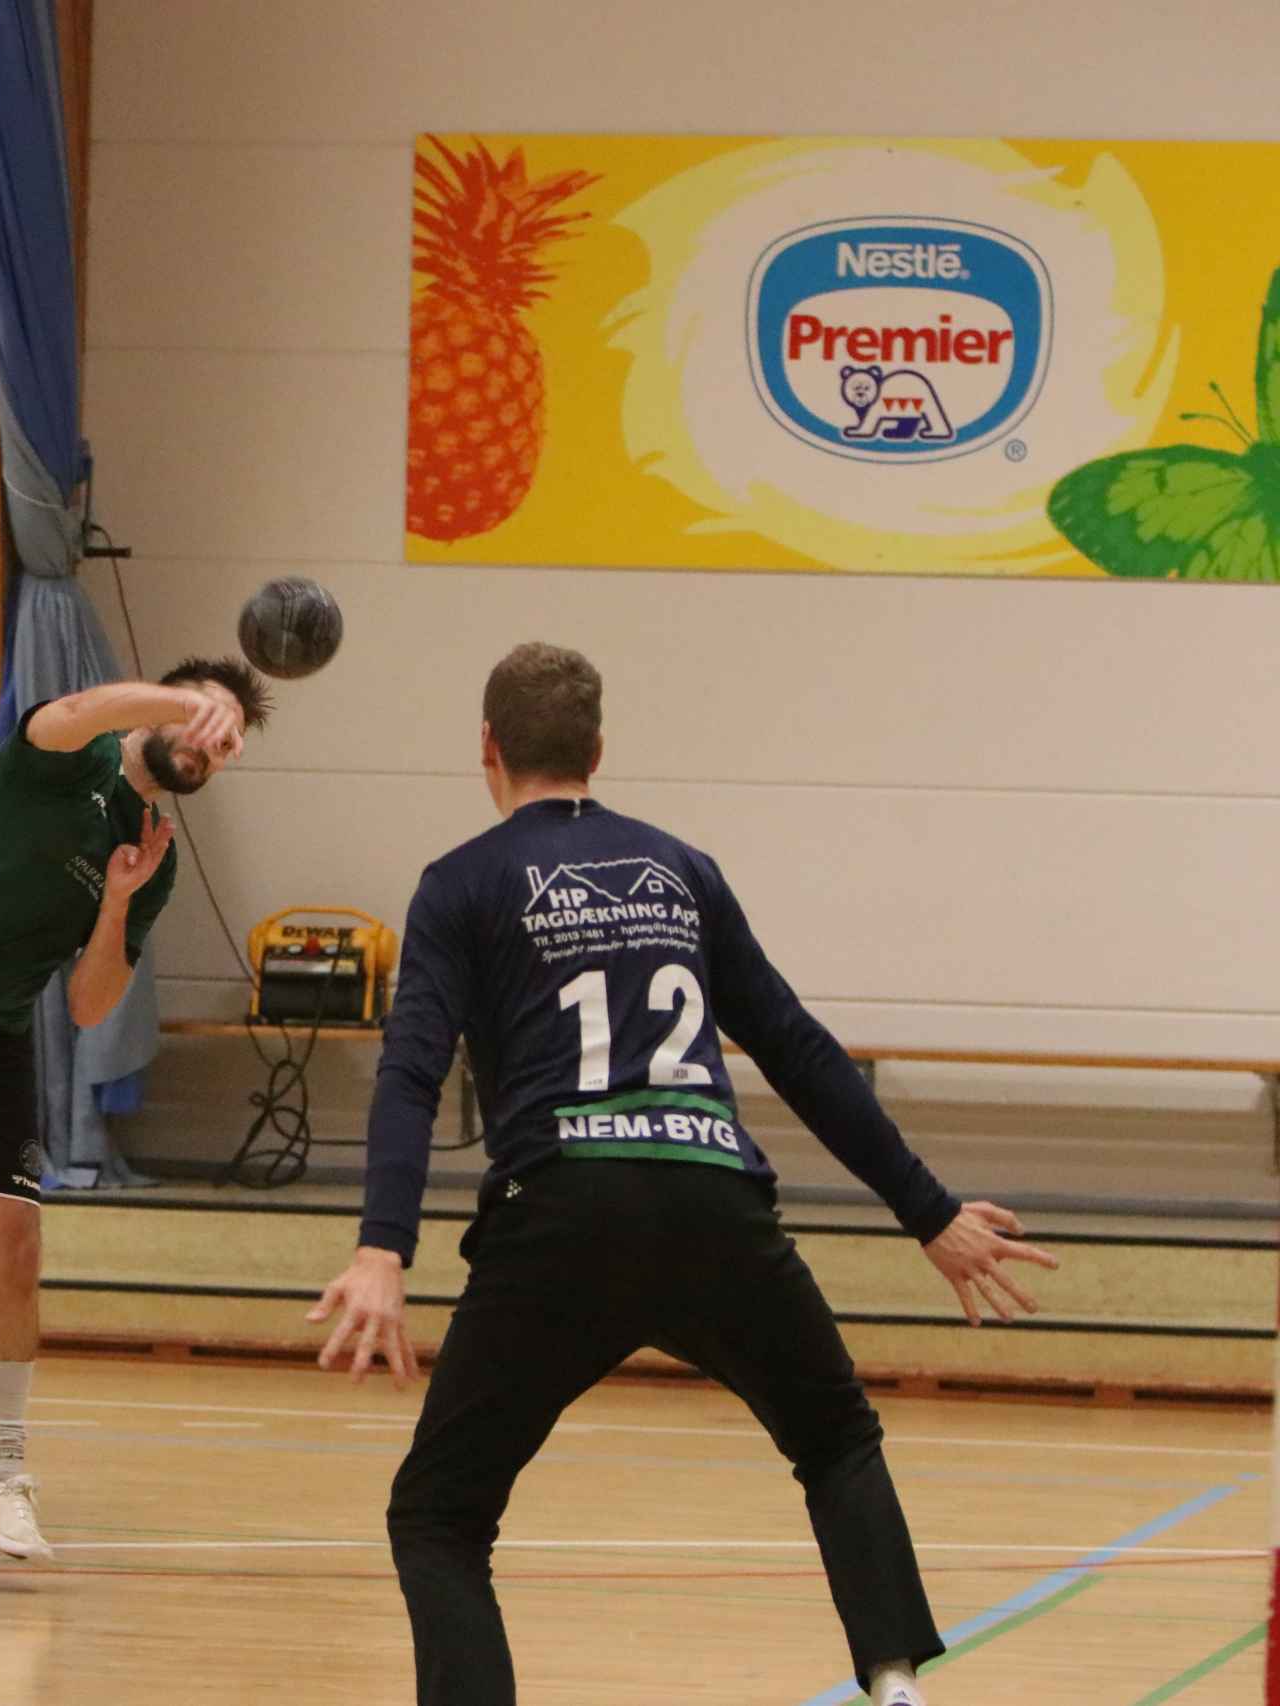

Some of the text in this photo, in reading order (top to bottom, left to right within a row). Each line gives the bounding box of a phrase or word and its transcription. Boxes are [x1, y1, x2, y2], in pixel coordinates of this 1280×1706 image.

[788, 313, 1014, 365] Premier
[522, 902, 667, 933] TAGDÆKNING
[547, 888, 589, 909] HP
[558, 963, 713, 1091] 12
